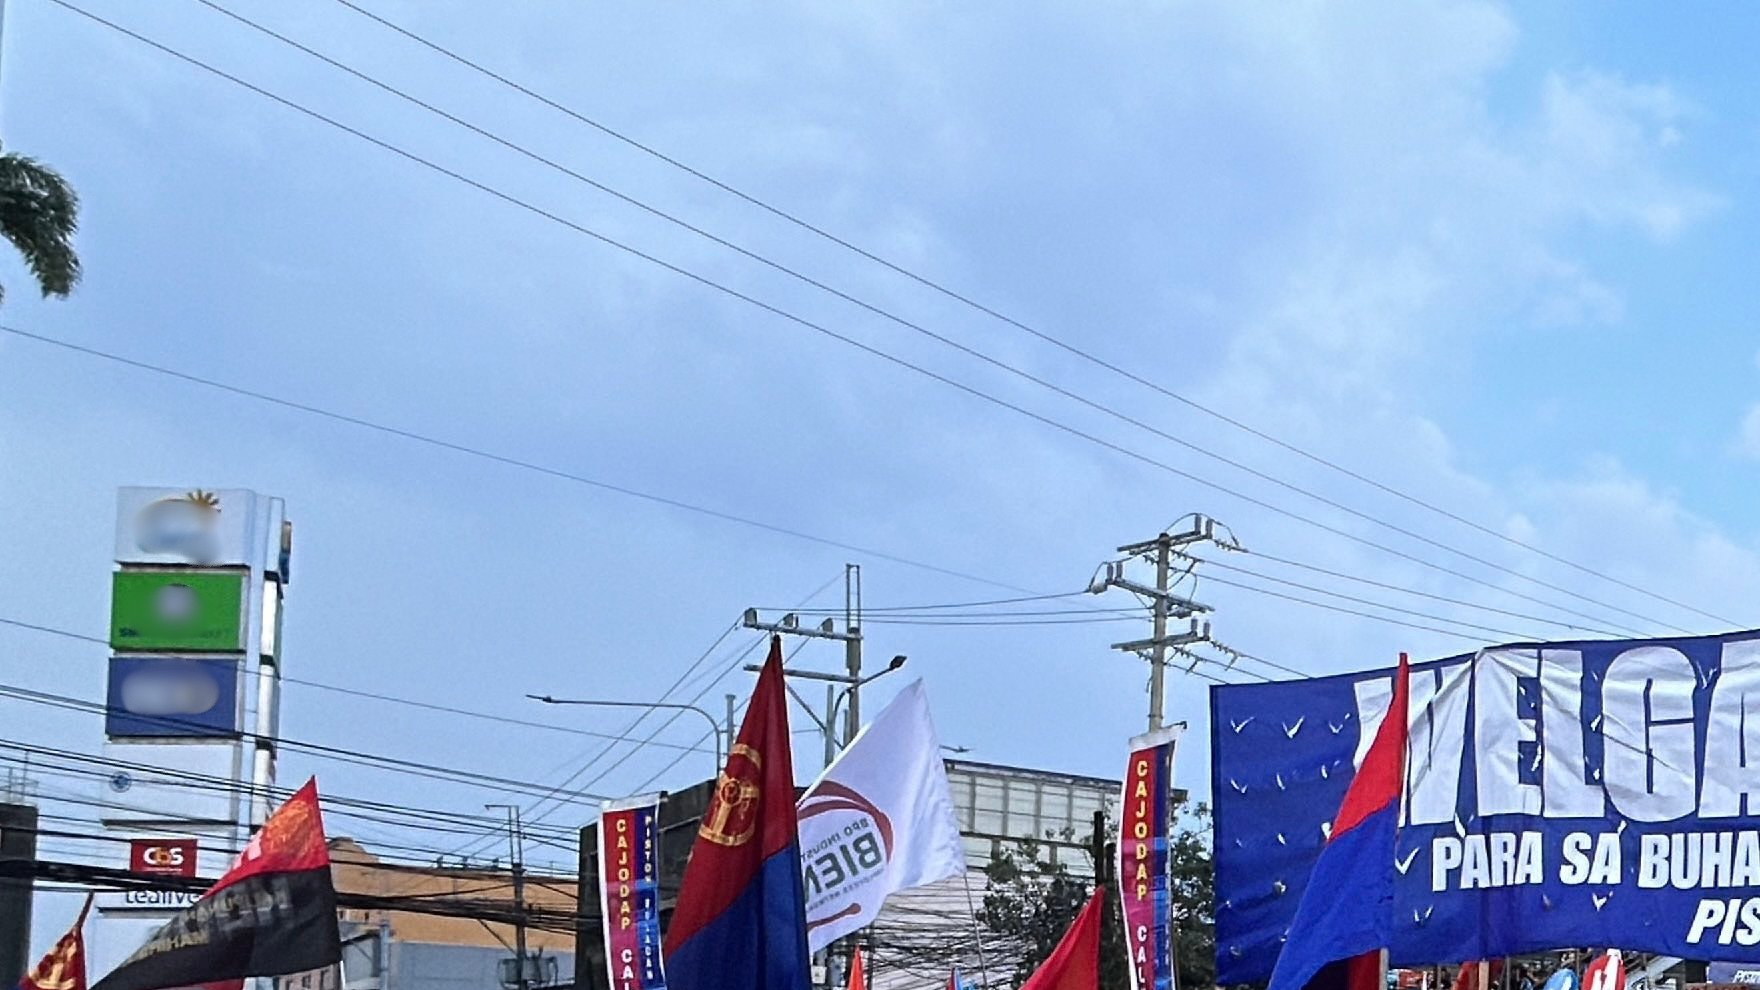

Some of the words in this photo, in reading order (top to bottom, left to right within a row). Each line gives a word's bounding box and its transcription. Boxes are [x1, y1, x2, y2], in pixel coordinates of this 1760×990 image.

[614, 818, 632, 931] CAJODAP
[1134, 760, 1149, 901] CAJODAP
[1432, 831, 1543, 892] PARA
[1559, 831, 1623, 887] SA
